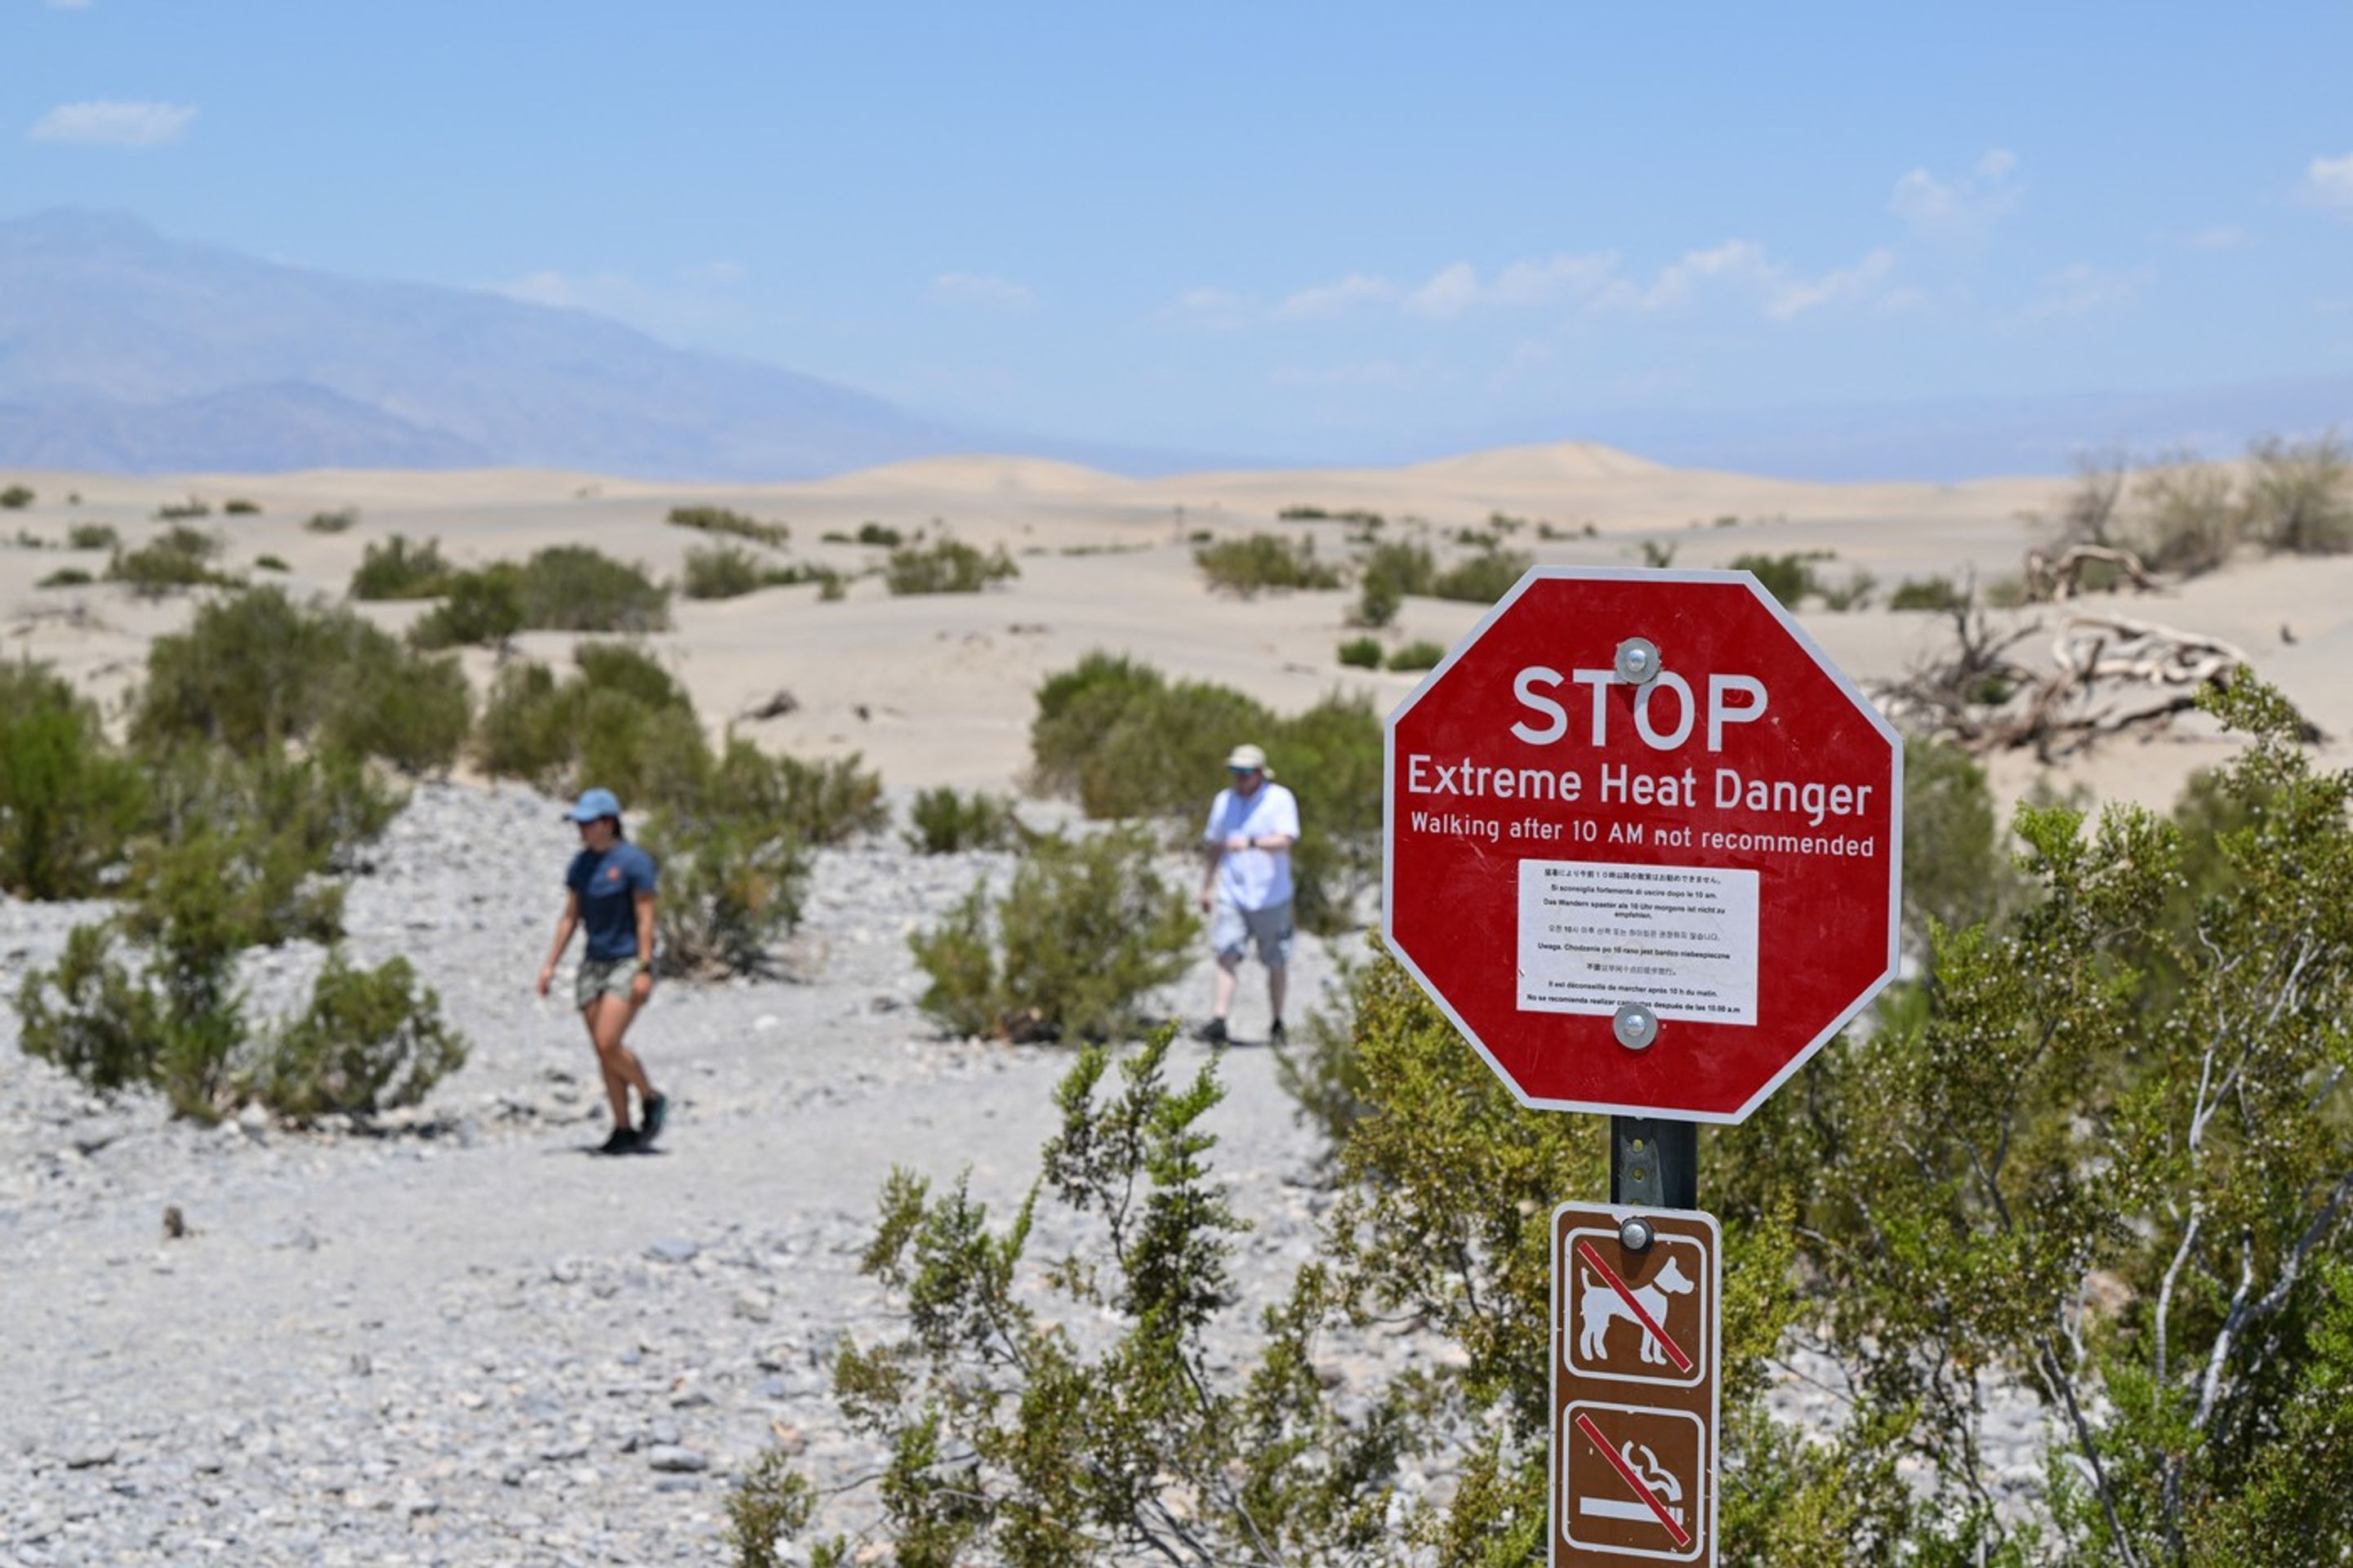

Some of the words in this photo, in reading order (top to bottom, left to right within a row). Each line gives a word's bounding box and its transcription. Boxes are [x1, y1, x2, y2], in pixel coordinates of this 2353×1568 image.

[1511, 666, 1767, 751] STOP
[1410, 755, 1580, 800] Extreme
[1602, 764, 1696, 807] Heat
[1716, 768, 1872, 826] Danger
[1412, 812, 1498, 842] Walking
[1510, 818, 1562, 839] after
[1574, 821, 1596, 841] 10
[1609, 823, 1642, 844] AM
[1656, 827, 1691, 846] not
[1703, 832, 1873, 856] recommended
